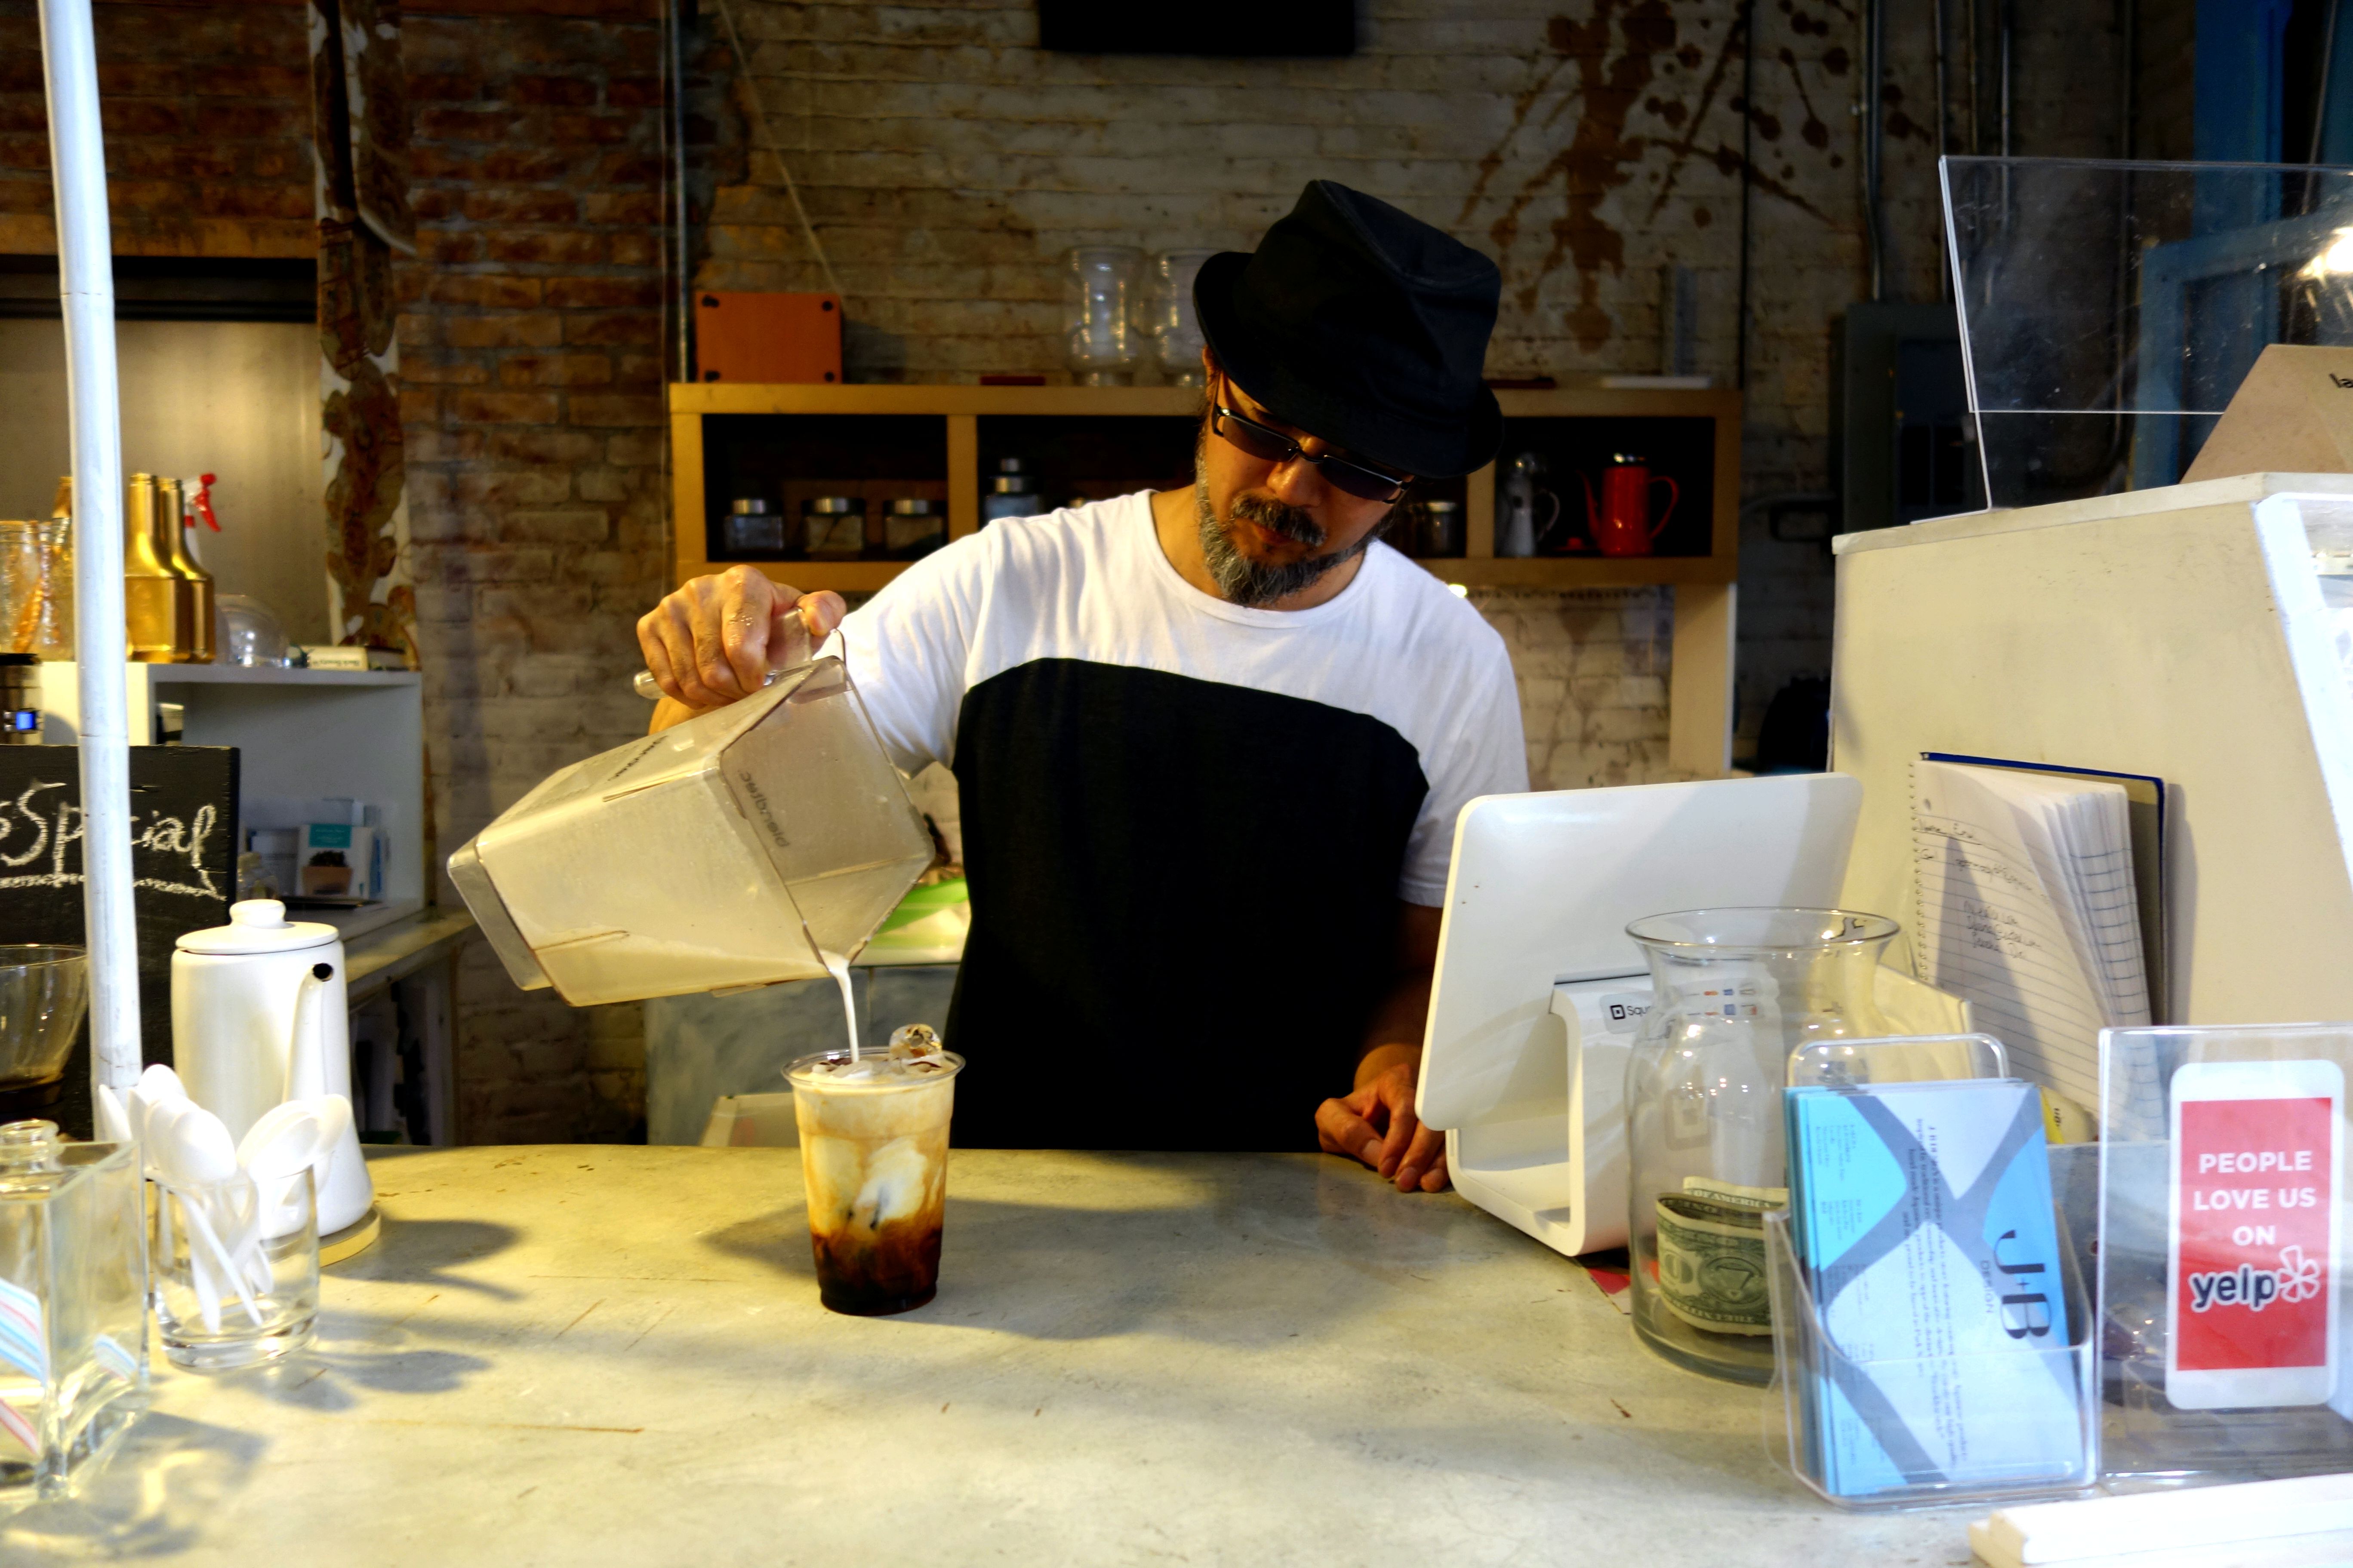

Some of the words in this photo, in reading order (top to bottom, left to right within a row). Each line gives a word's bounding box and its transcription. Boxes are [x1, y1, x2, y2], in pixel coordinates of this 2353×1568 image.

[1, 779, 222, 897] Spial
[2199, 1150, 2313, 1174] PEOPLE
[2193, 1188, 2270, 1211] LOVE
[2278, 1187, 2317, 1208] US
[2232, 1225, 2276, 1246] ON
[2190, 1265, 2276, 1310] yelp
